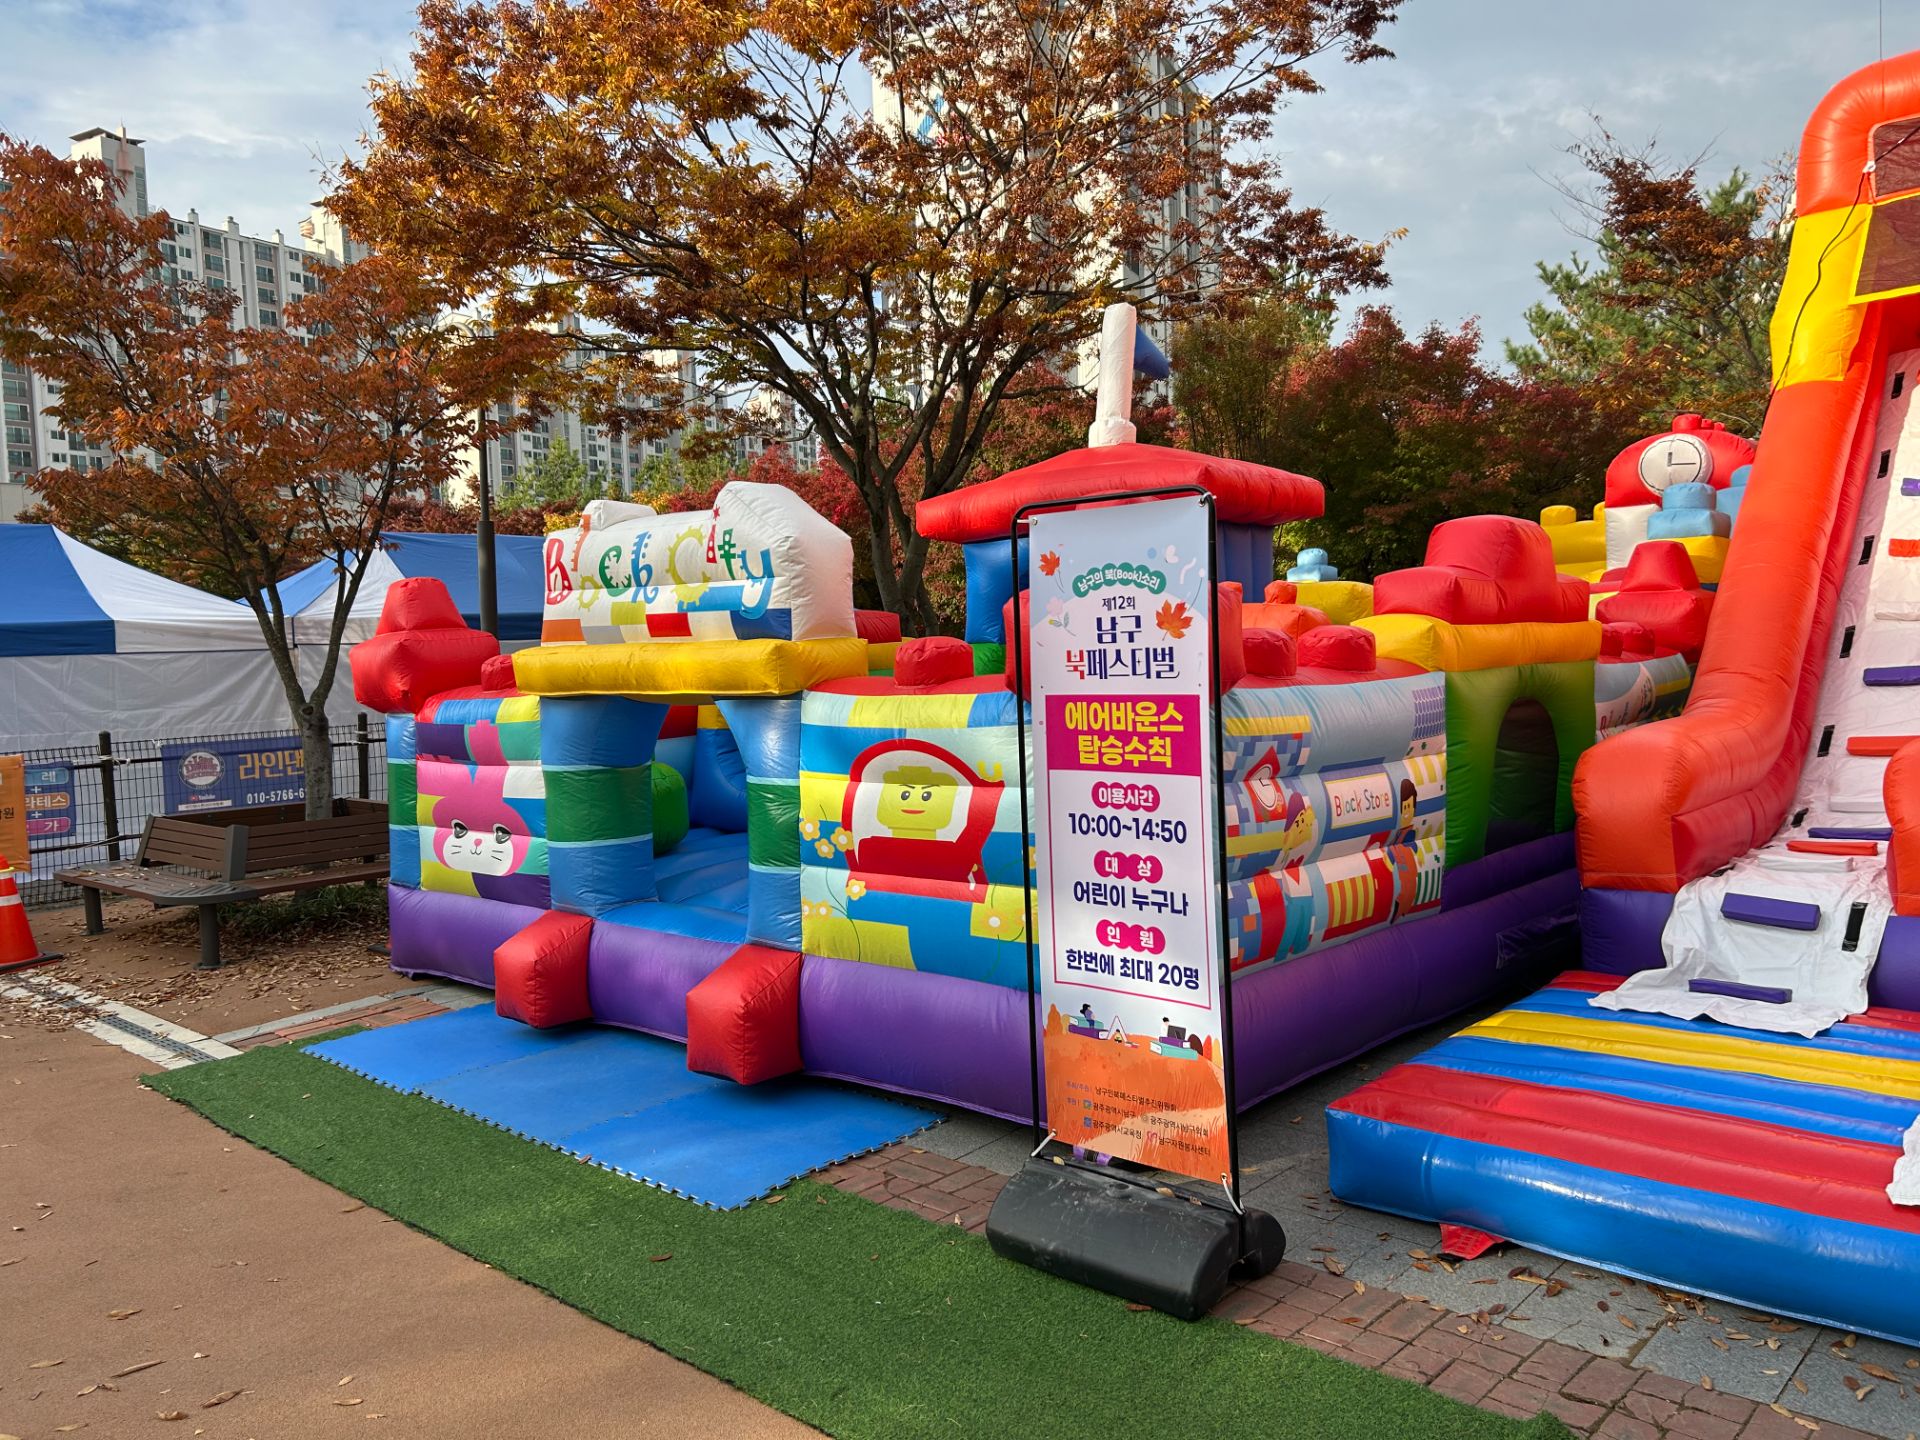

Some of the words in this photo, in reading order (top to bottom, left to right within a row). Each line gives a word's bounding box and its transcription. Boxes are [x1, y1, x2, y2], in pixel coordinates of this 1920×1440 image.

[666, 504, 775, 619] City
[1077, 571, 1104, 592] 남구의
[1102, 595, 1136, 610] 제12회
[1096, 615, 1142, 644] 남구
[1065, 646, 1180, 680] 북페스티벌
[1065, 701, 1185, 733] 에어바운스
[1078, 735, 1173, 768] 탑승수칙
[246, 788, 307, 804] 010-5766-6
[1098, 787, 1154, 806] 이용시간
[1334, 790, 1362, 817] Block
[1363, 788, 1390, 811] Store
[0, 807, 14, 819] 원
[1068, 812, 1187, 844] 10:00~14:50
[1073, 880, 1126, 909] 어린이
[1131, 886, 1188, 917] 누구나
[1066, 948, 1115, 977] 한번에
[1120, 955, 1152, 983] 최대
[1158, 963, 1200, 990] 20명
